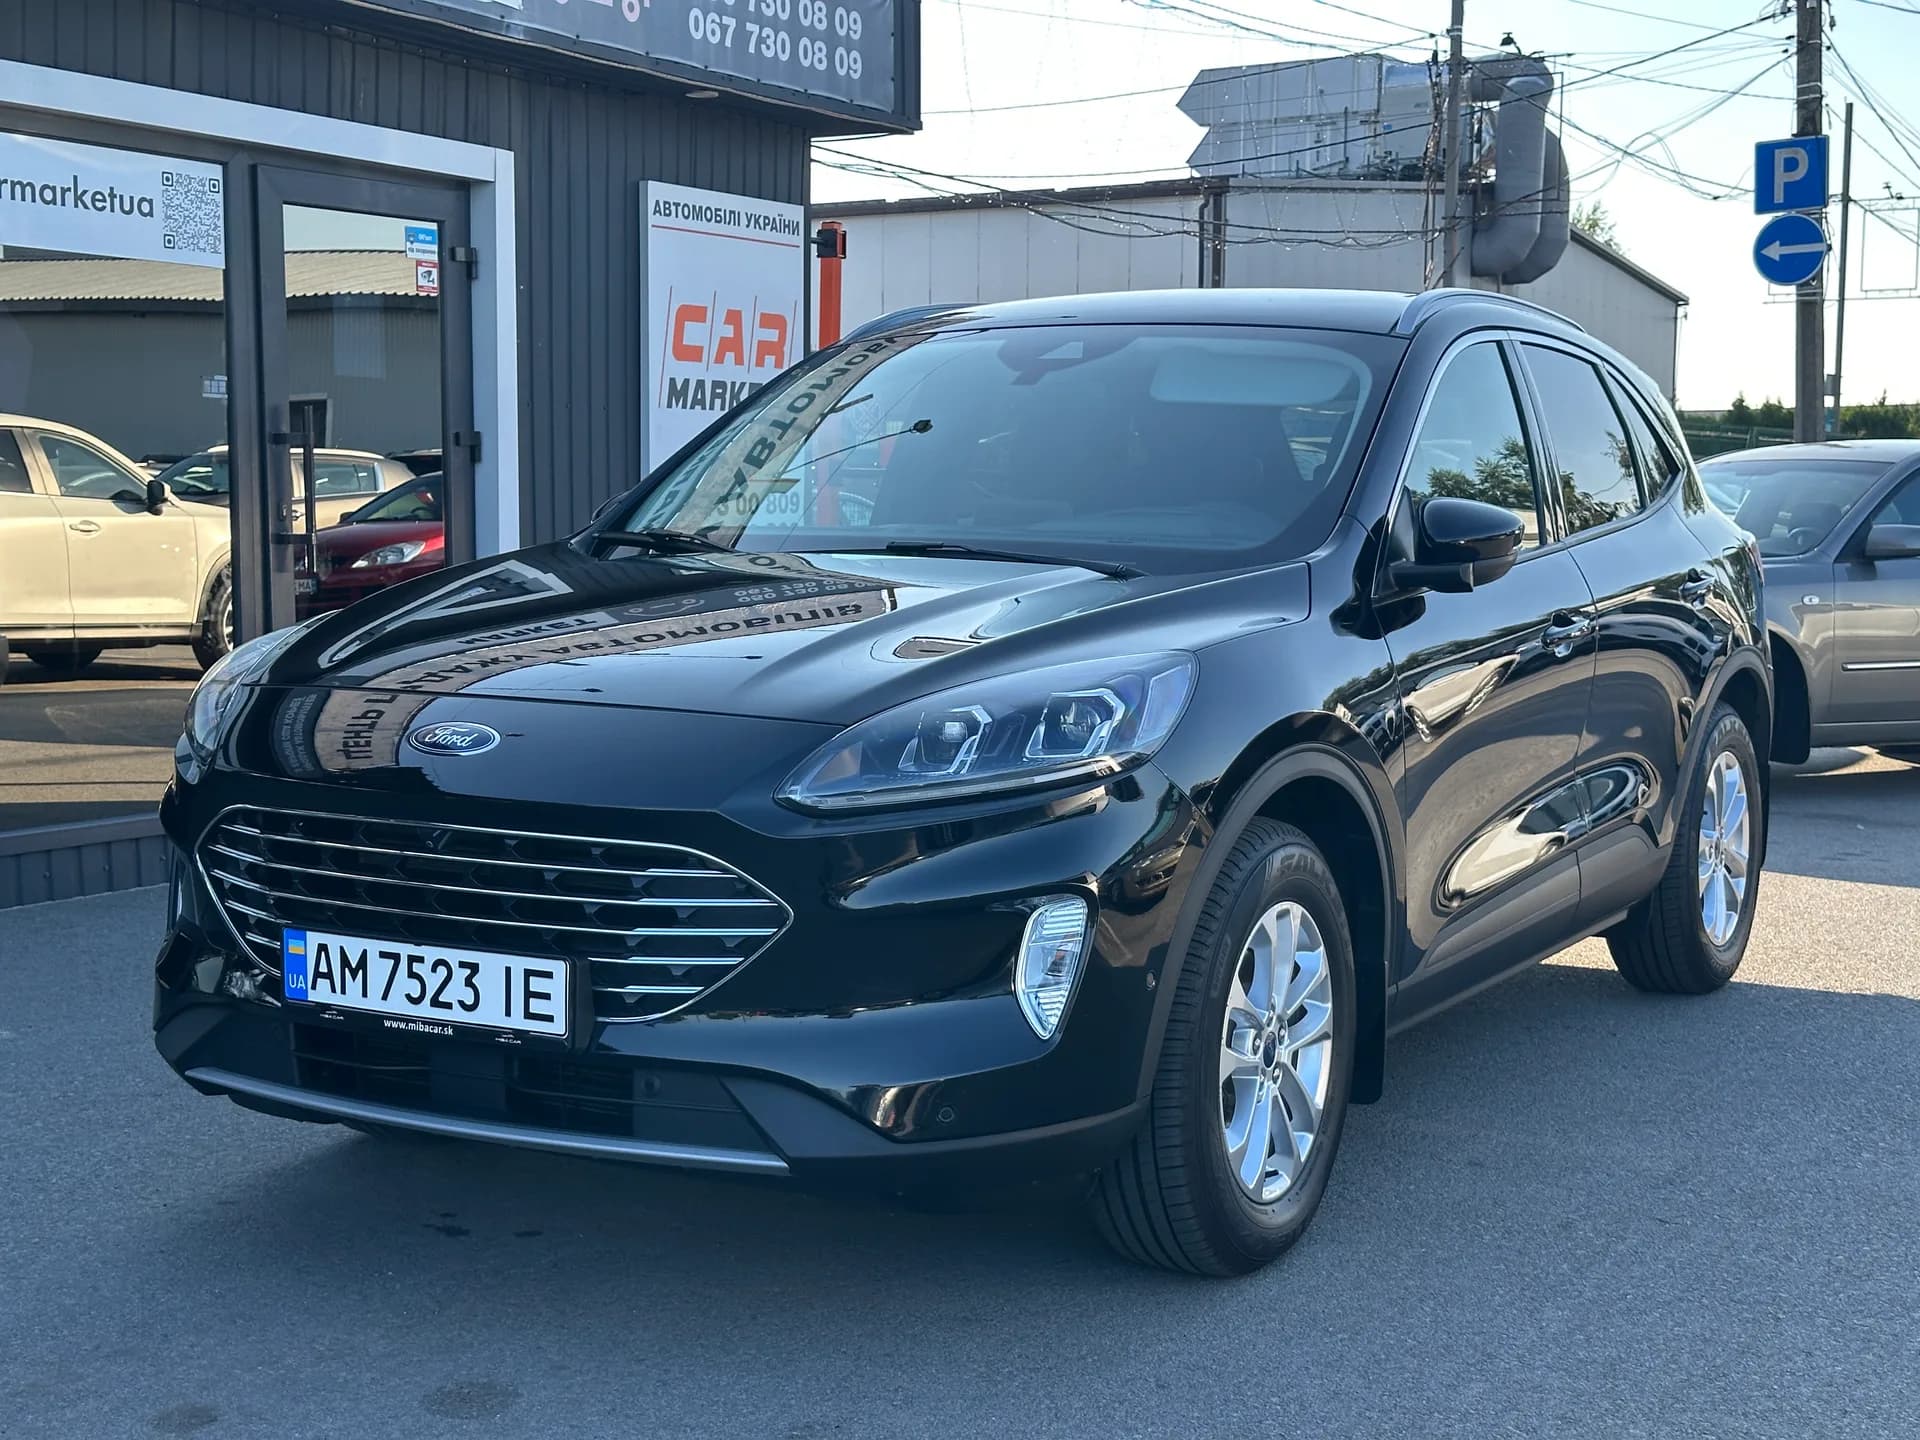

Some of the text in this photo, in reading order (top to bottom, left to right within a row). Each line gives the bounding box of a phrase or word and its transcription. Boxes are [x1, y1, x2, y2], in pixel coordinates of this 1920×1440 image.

[799, 0, 828, 31] 08
[835, 6, 862, 41] 09
[688, 7, 737, 49] 067
[745, 22, 791, 62] 730
[799, 36, 828, 71] 08
[835, 46, 862, 80] 09
[0, 174, 154, 218] rmarketua
[1773, 147, 1809, 204] P
[652, 199, 801, 237] АВТОМОБІЛІ УКРАЇНИ
[671, 303, 788, 370] CAR
[425, 726, 479, 747] Ford
[288, 973, 306, 990] UA
[310, 942, 555, 1024] AM 7523 IE
[383, 1018, 454, 1037] www.mibacar.sk
